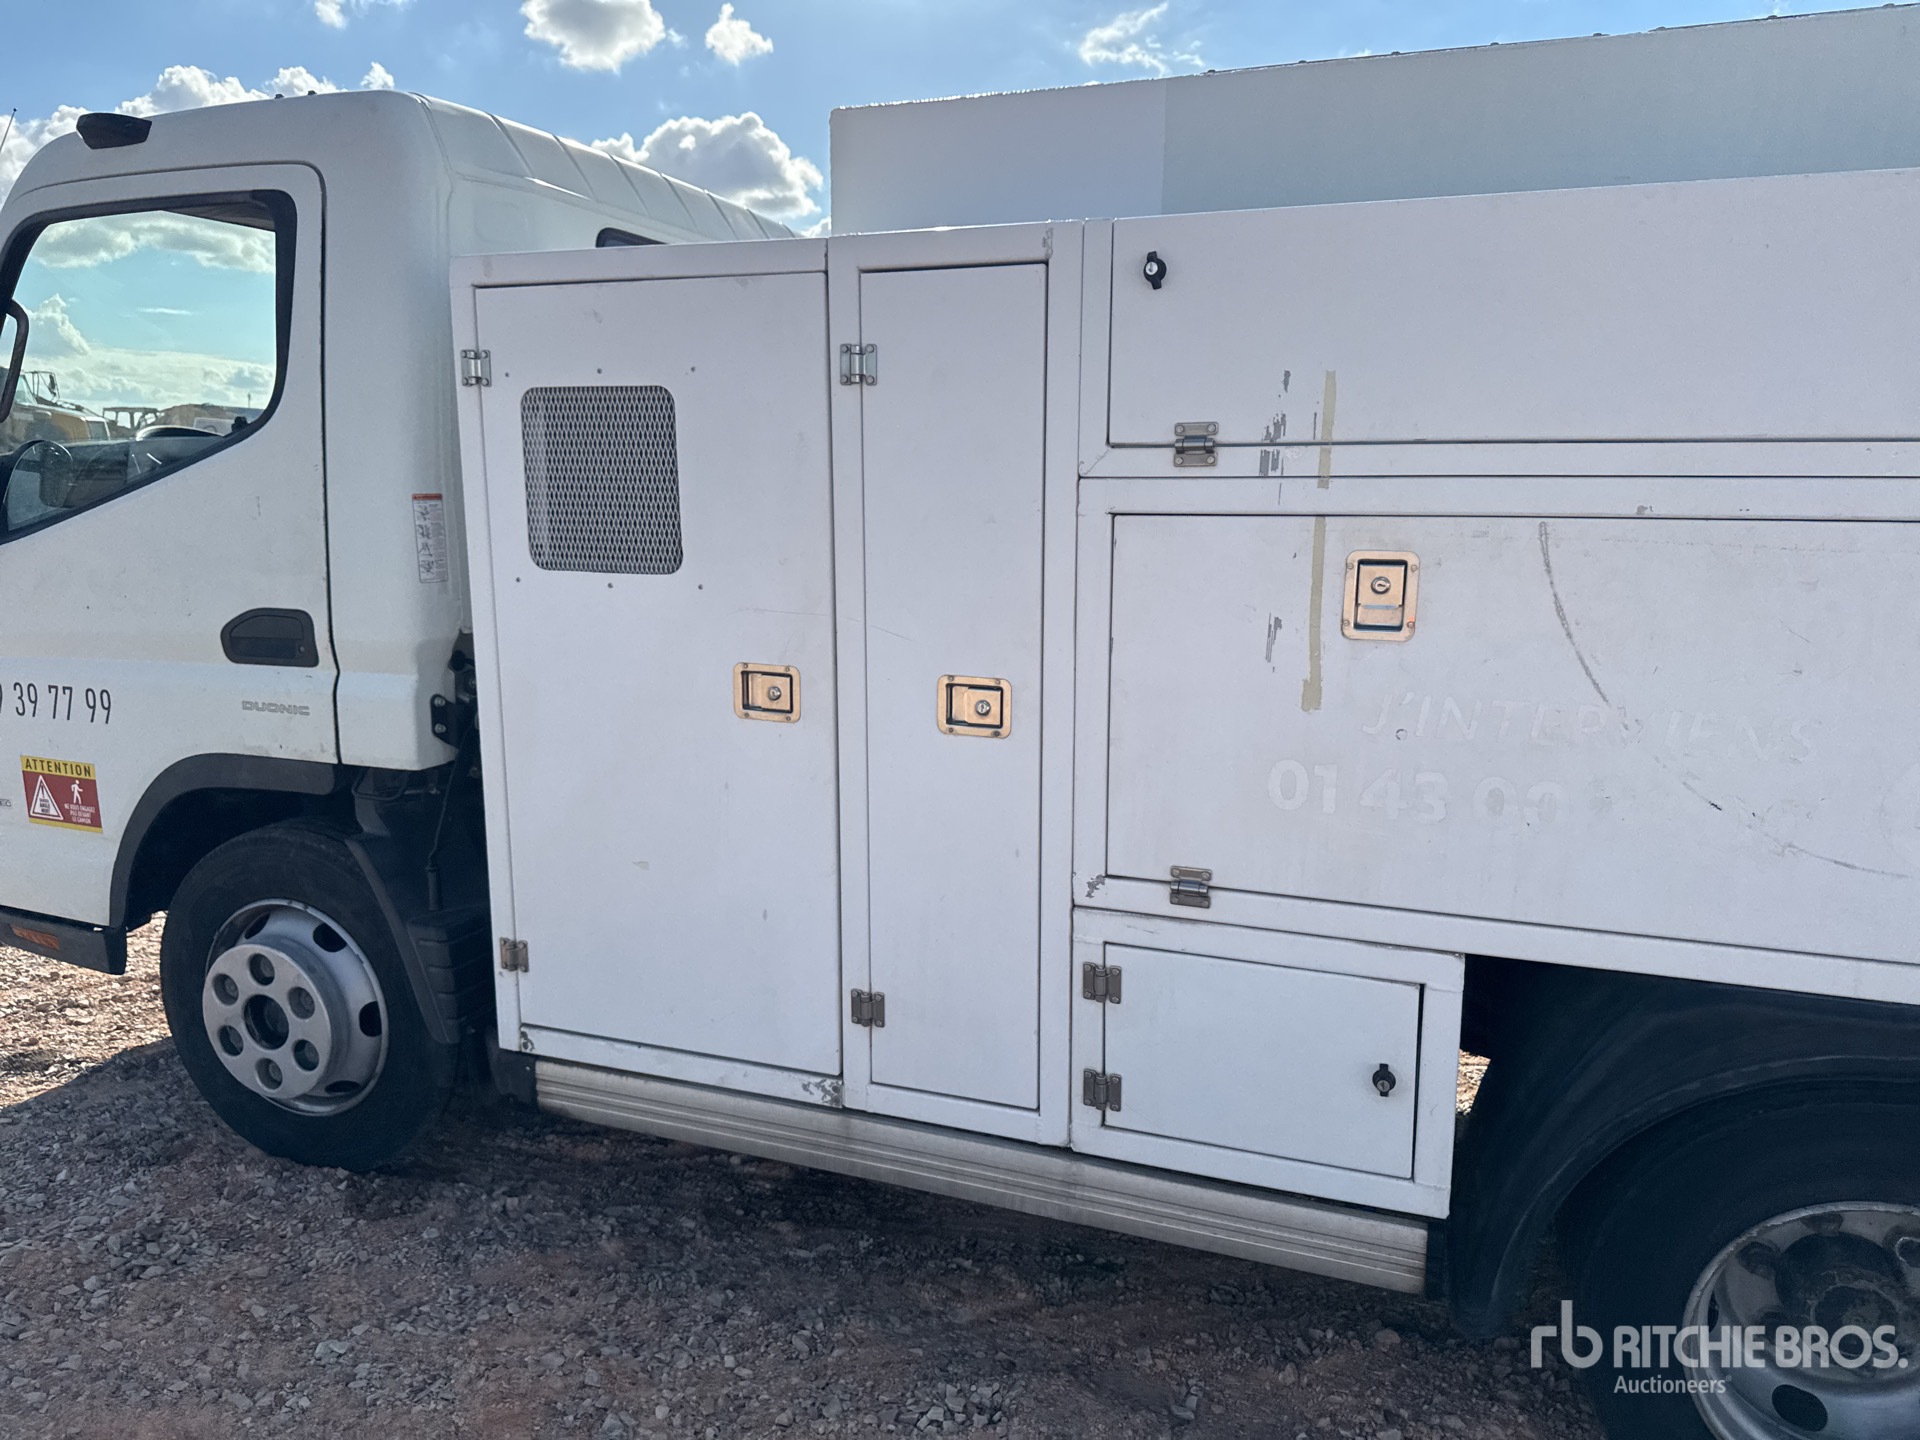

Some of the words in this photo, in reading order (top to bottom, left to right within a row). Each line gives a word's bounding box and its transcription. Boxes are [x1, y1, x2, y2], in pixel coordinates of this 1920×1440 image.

[13, 681, 38, 718] 39
[48, 684, 73, 721] 77
[85, 687, 112, 724] 99
[241, 700, 310, 716] DUONIC
[25, 758, 91, 777] ATTENTION
[1267, 759, 1337, 815] 01
[1359, 769, 1449, 824] 43
